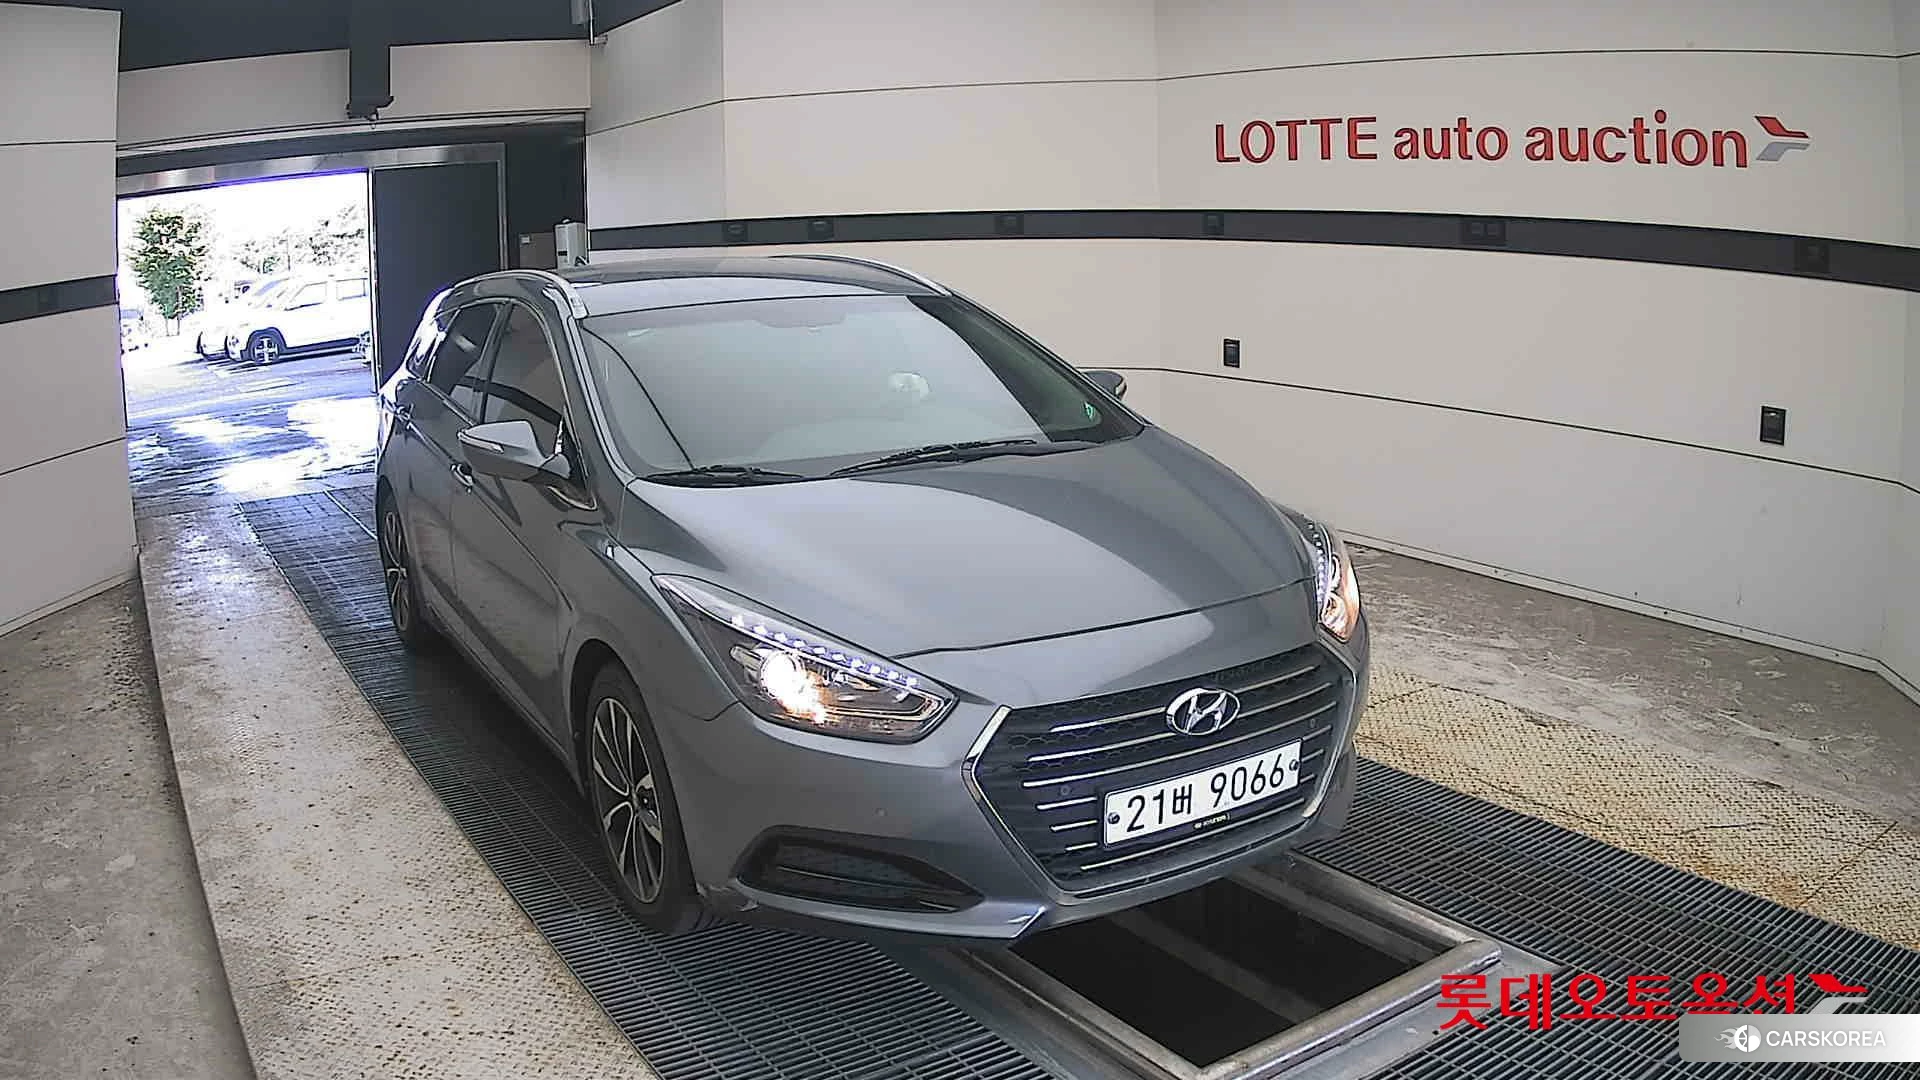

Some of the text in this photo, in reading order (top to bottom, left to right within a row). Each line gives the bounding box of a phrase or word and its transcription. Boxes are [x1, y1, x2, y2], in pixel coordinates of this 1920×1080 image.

[1215, 111, 1749, 168] LOTTE auto auction
[1126, 753, 1285, 833] 21버 9066
